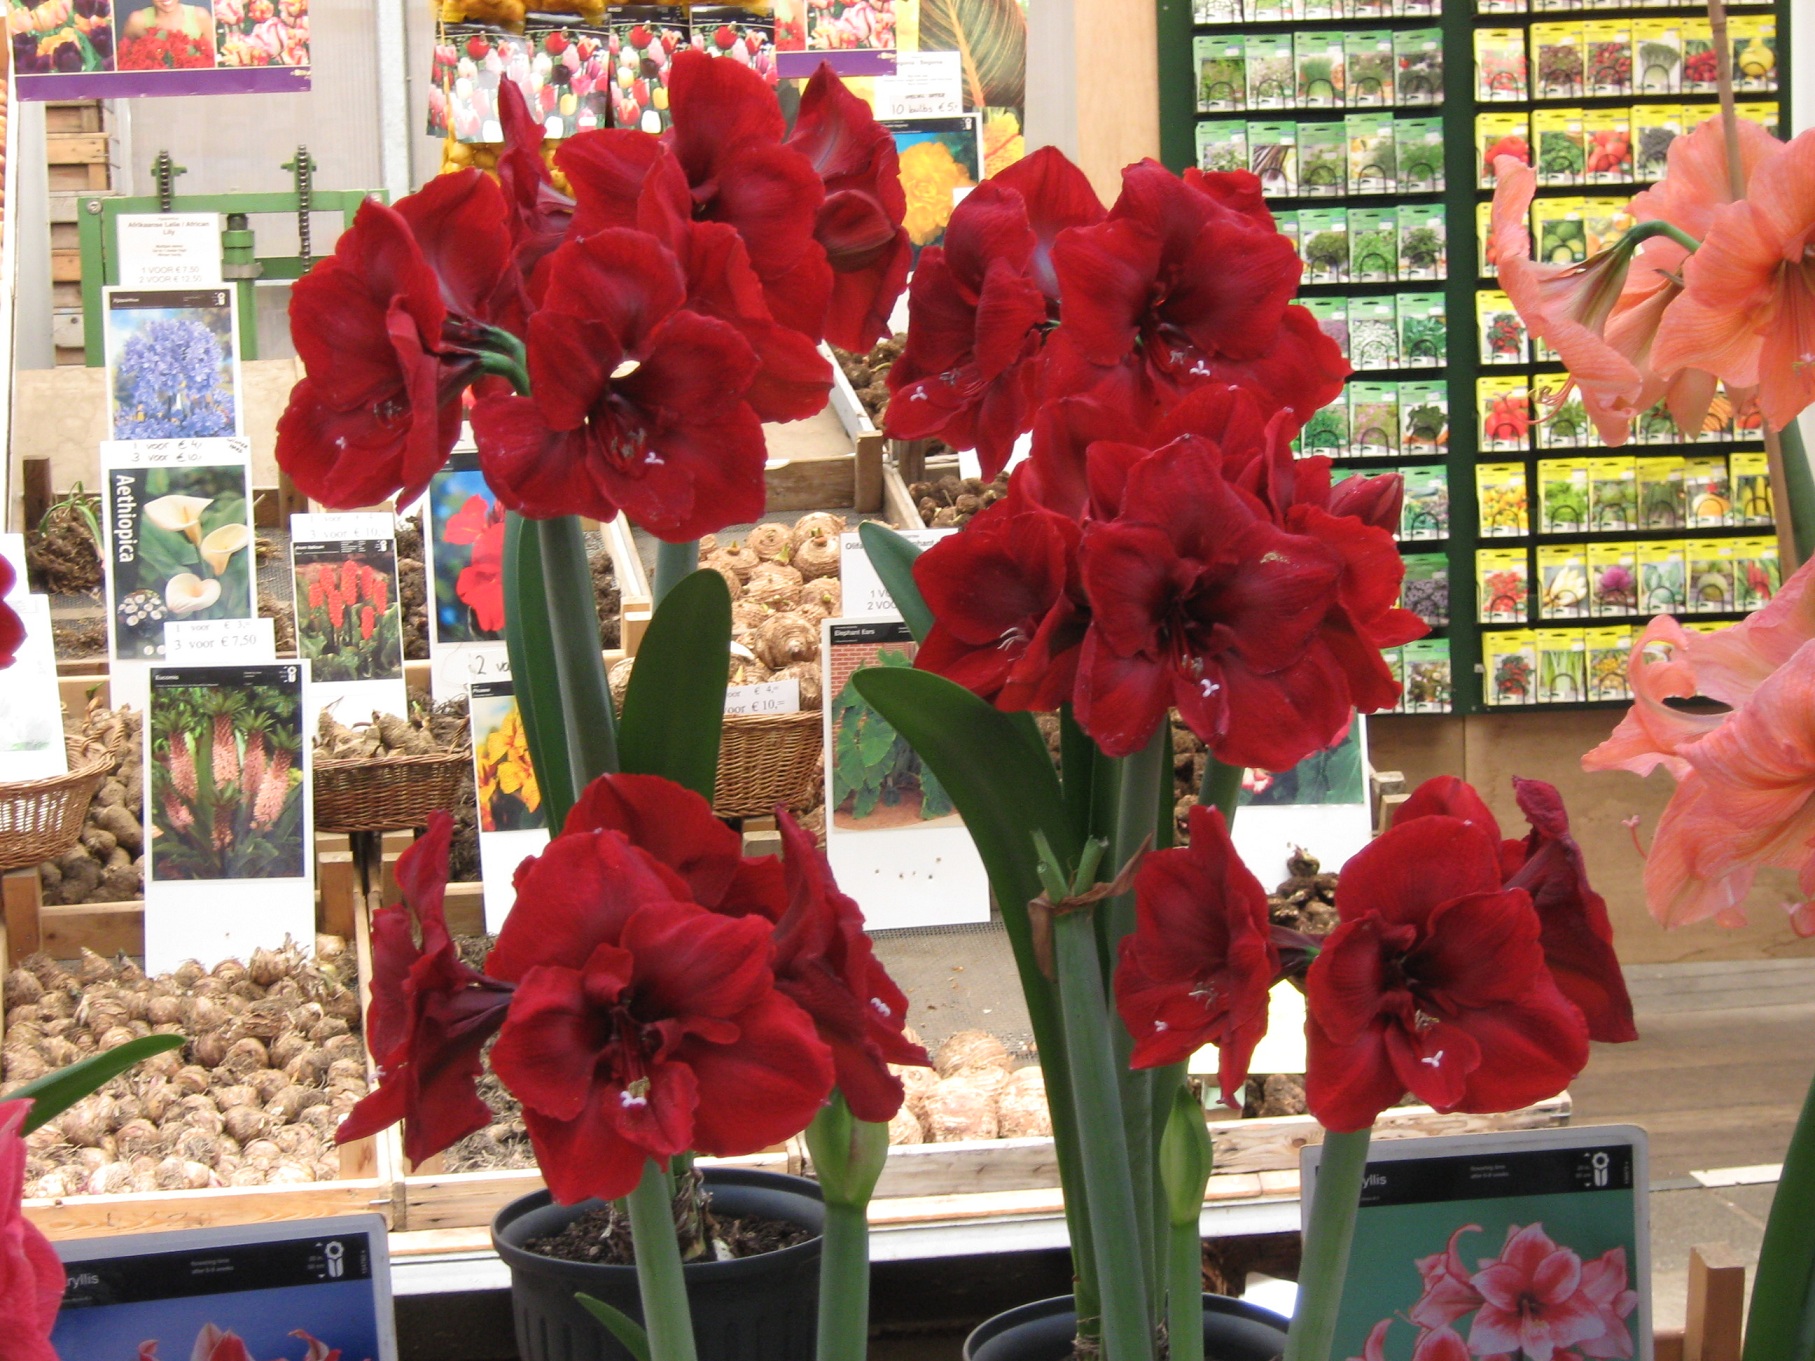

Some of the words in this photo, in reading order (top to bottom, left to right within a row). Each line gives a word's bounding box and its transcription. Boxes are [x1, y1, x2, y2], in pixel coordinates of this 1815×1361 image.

[892, 103, 905, 115] 10
[131, 452, 140, 462] 3
[113, 475, 138, 562] Aethiopica
[870, 590, 875, 598] 1
[867, 601, 873, 610] 2
[875, 601, 897, 609] VOO
[174, 639, 182, 650] 3
[189, 639, 215, 649] voor
[221, 636, 229, 647] €
[475, 654, 487, 675] 2
[726, 690, 741, 698] oor
[751, 701, 760, 712] €
